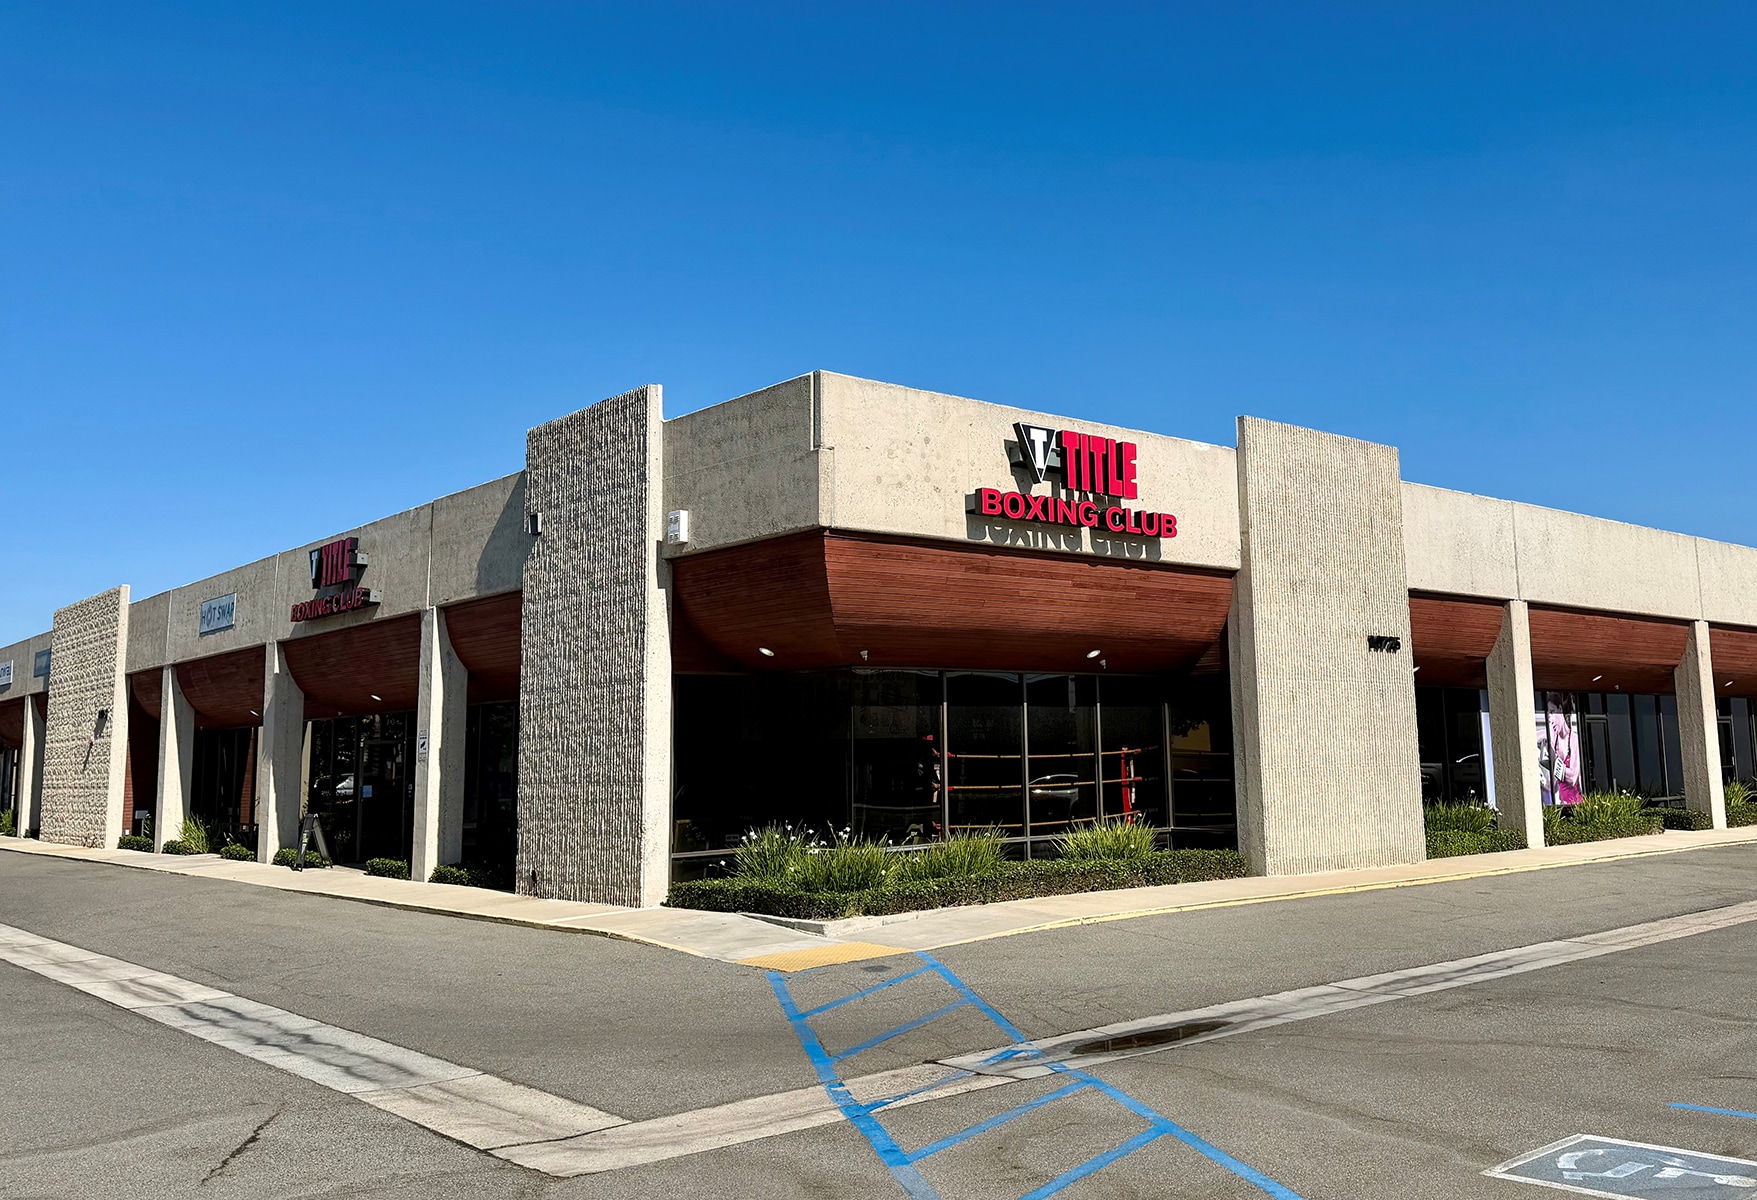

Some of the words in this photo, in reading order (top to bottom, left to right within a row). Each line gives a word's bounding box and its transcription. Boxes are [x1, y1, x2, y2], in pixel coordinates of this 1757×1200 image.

[1061, 430, 1138, 500] TITLE
[979, 487, 1099, 528] BOXING
[1106, 506, 1178, 539] CLUB
[321, 537, 354, 587] TITLE
[201, 604, 217, 628] HOT
[217, 602, 235, 624] SWAP
[290, 595, 331, 622] BOXING
[332, 588, 364, 613] CLUB
